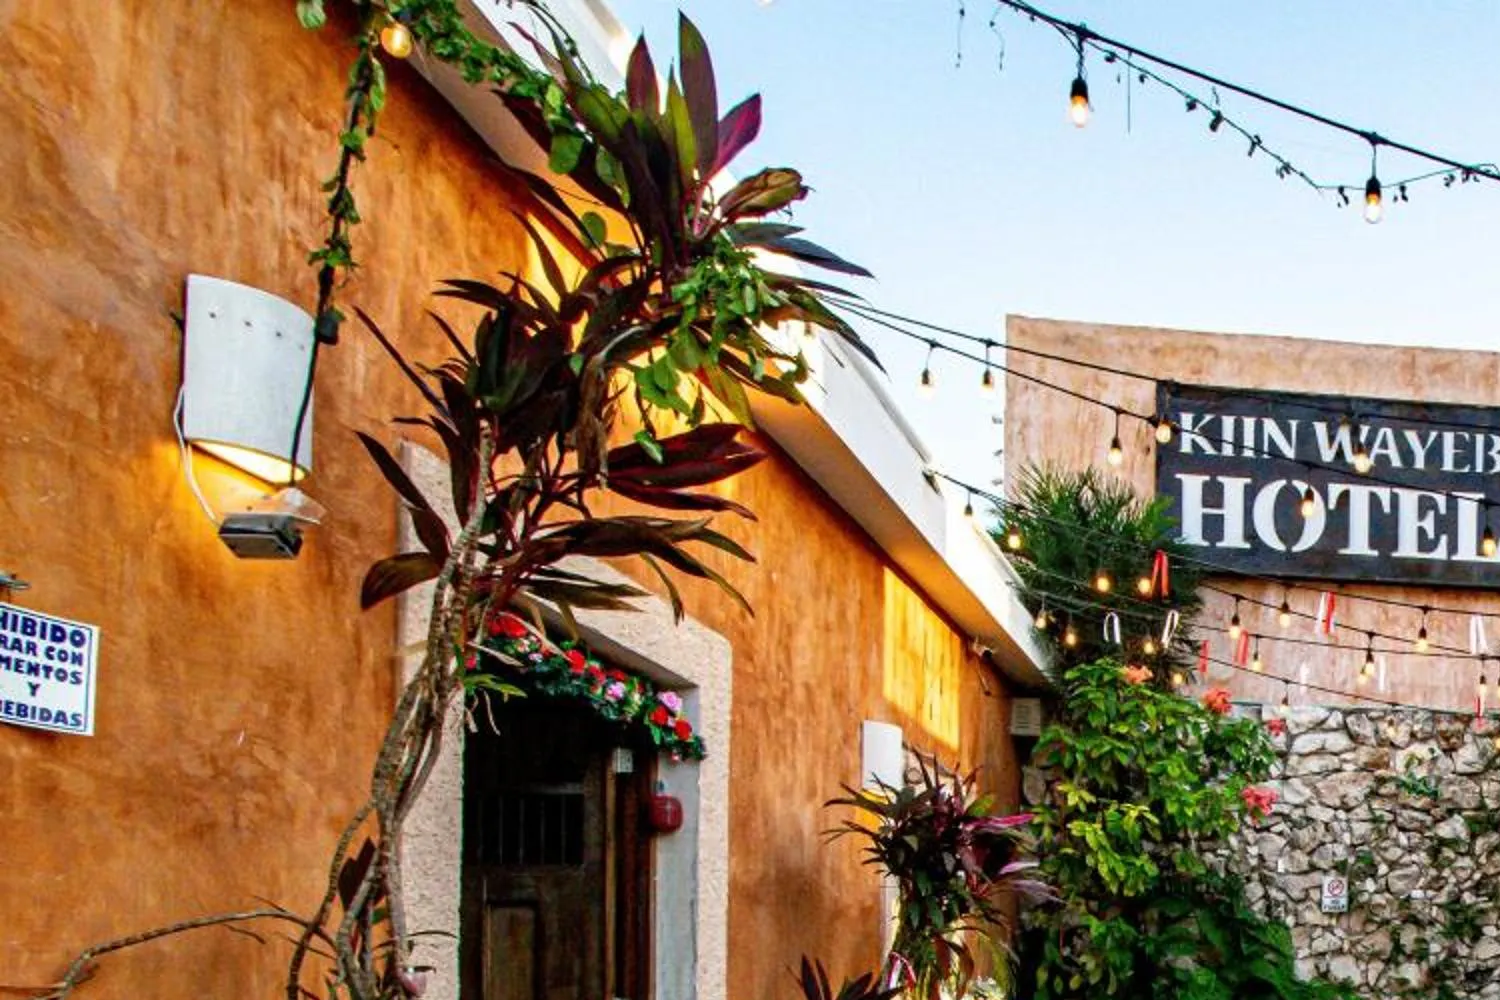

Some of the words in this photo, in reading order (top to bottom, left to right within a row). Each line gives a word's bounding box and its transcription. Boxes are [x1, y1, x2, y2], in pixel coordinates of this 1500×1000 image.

[1179, 412, 1298, 460] KIIN
[44, 646, 83, 666] CON
[28, 682, 41, 697] Y
[0, 700, 82, 727] EBIDAS
